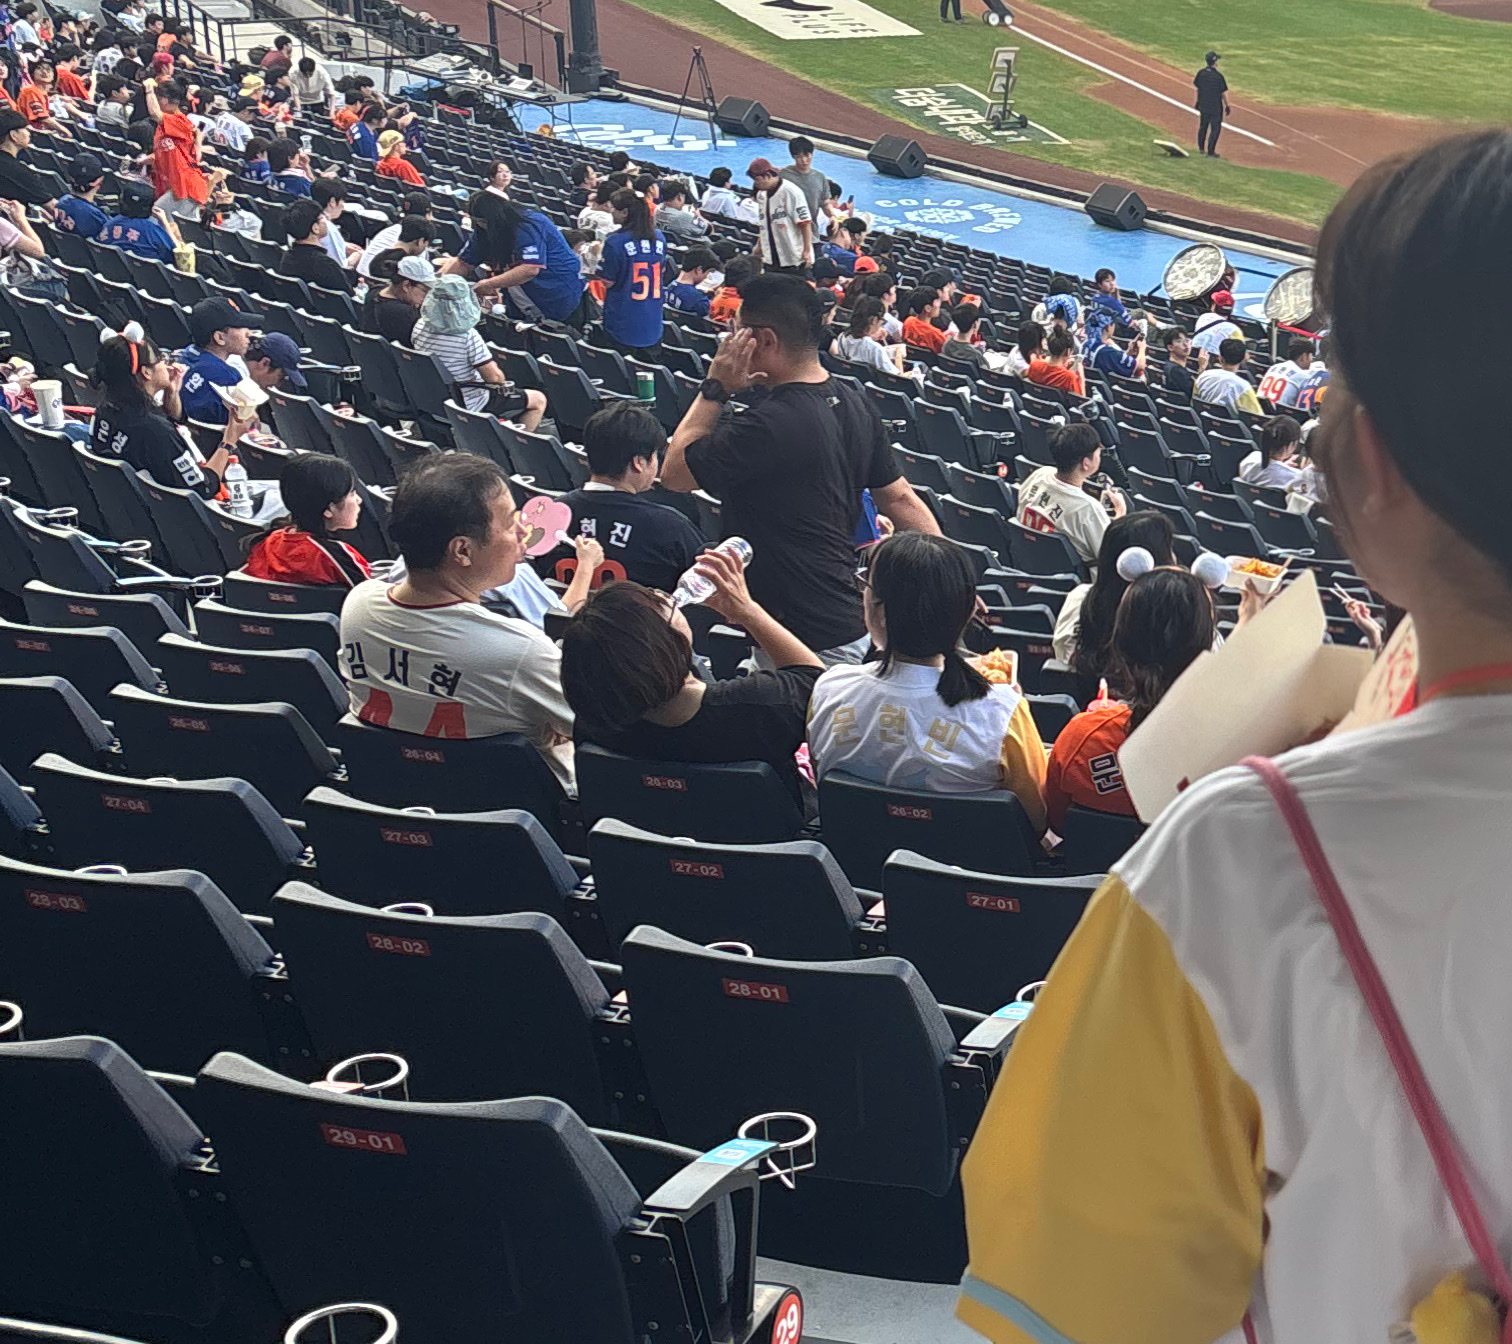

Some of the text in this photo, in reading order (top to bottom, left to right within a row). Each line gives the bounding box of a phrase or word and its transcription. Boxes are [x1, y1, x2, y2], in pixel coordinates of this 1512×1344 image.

[631, 261, 661, 301] 51
[1260, 375, 1288, 403] 99
[344, 641, 462, 698] 김서현
[832, 703, 963, 760] 문현빈
[105, 797, 146, 811] 27-04
[384, 831, 428, 845] 27-03
[674, 862, 719, 877] 27-02
[970, 895, 1014, 910] 27-01
[372, 937, 425, 954] 28-02
[729, 982, 781, 999] 28-01
[328, 1128, 394, 1151] 29-01
